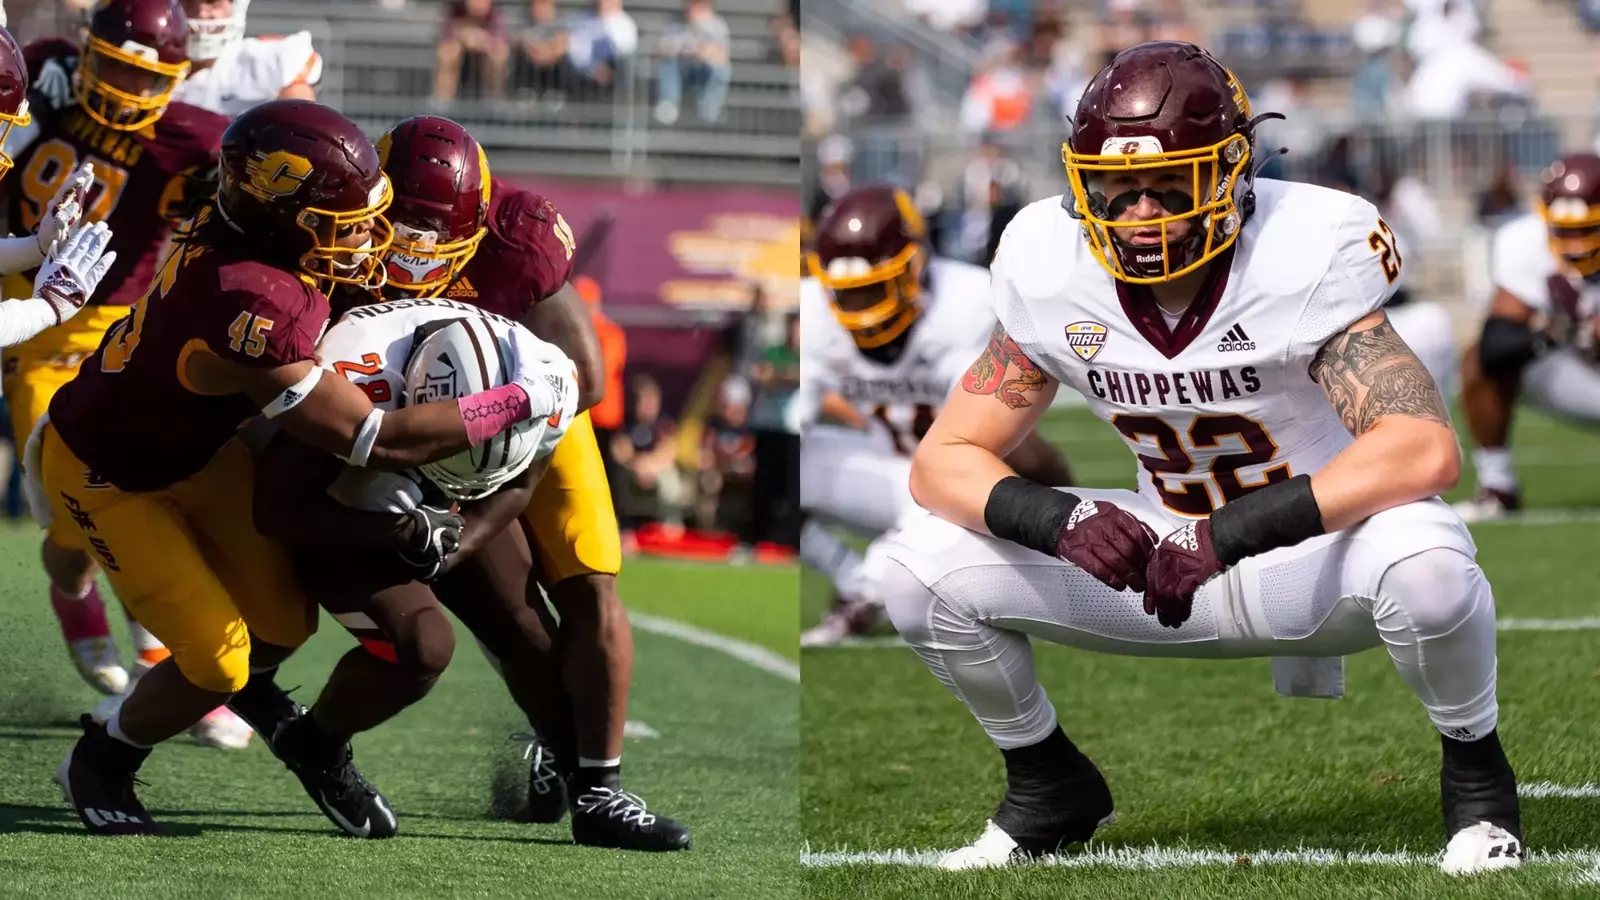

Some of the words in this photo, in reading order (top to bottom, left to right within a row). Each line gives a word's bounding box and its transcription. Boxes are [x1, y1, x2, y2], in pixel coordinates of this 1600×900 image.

[43, 277, 78, 290] adidas
[447, 290, 478, 298] adidas
[228, 310, 274, 358] 45
[1068, 334, 1105, 346] MAC
[1217, 340, 1256, 353] adidas
[1087, 367, 1261, 406] CHIPPEWAS
[1112, 412, 1293, 520] 22
